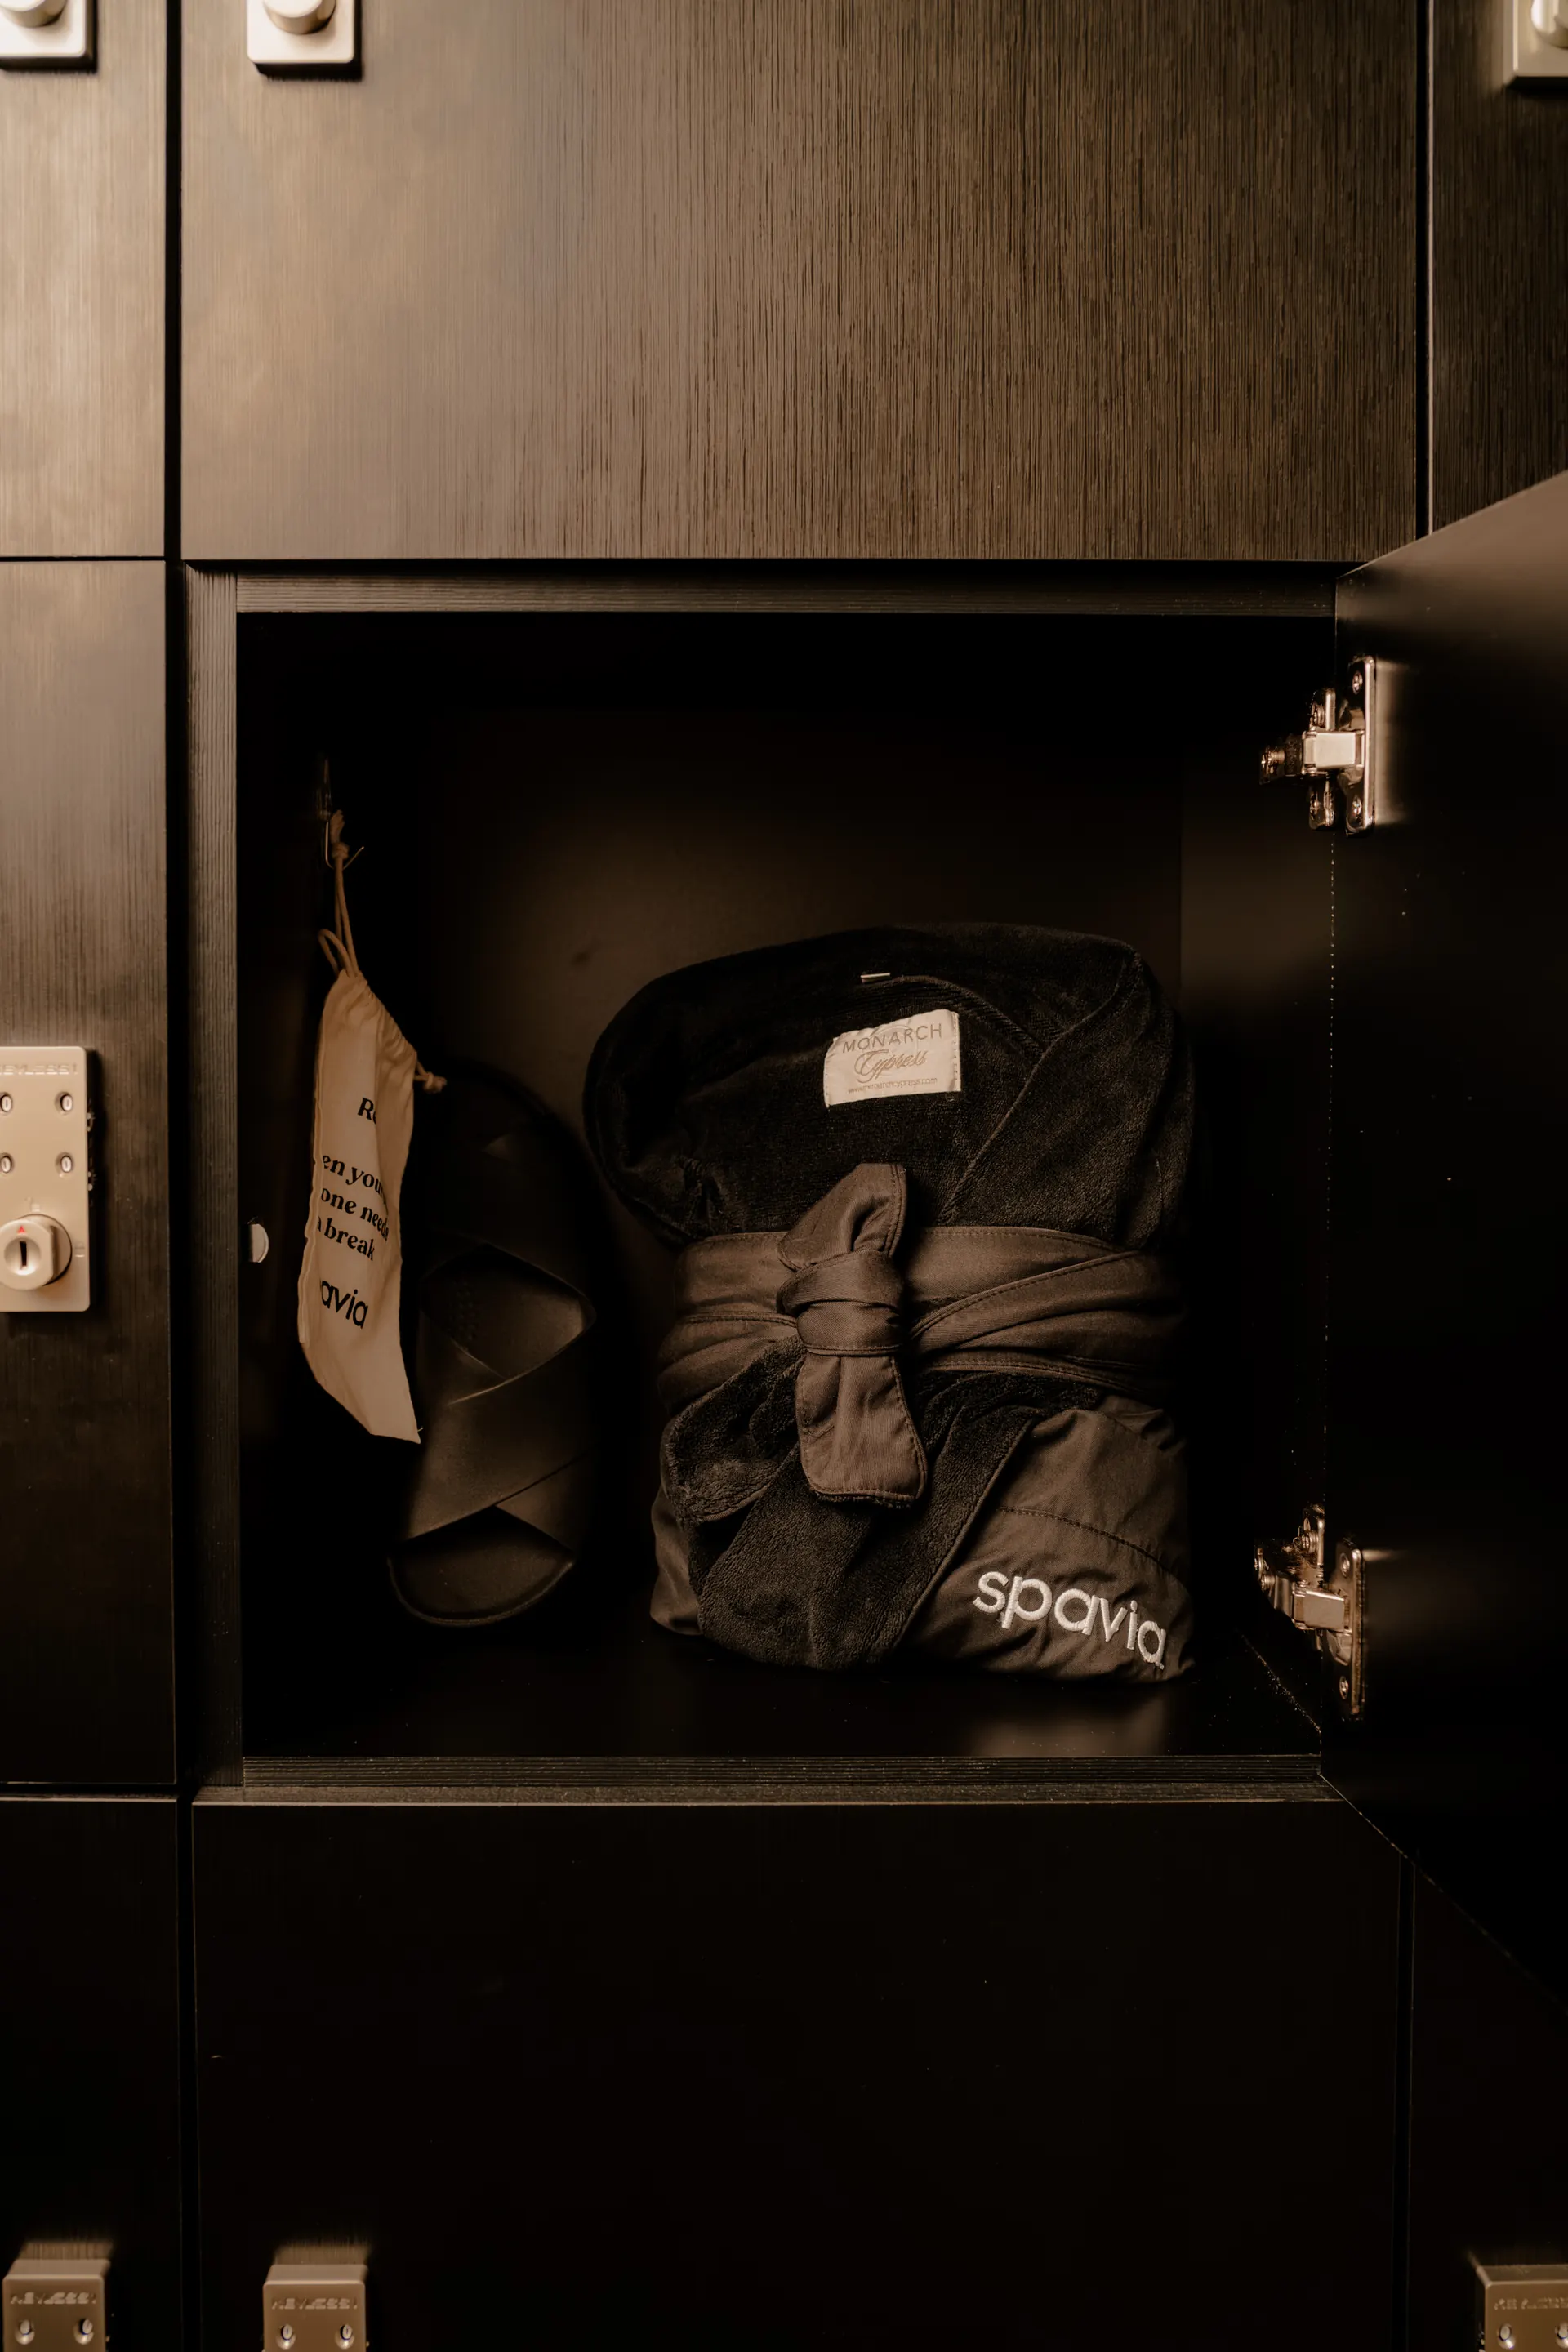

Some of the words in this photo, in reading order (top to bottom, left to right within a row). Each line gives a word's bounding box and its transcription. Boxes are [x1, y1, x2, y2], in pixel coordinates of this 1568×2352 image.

[842, 1022, 942, 1054] MONARCH
[853, 1049, 929, 1084] Cypress
[323, 1218, 376, 1261] break
[319, 1279, 369, 1330] avia
[972, 1570, 1167, 1671] spavia
